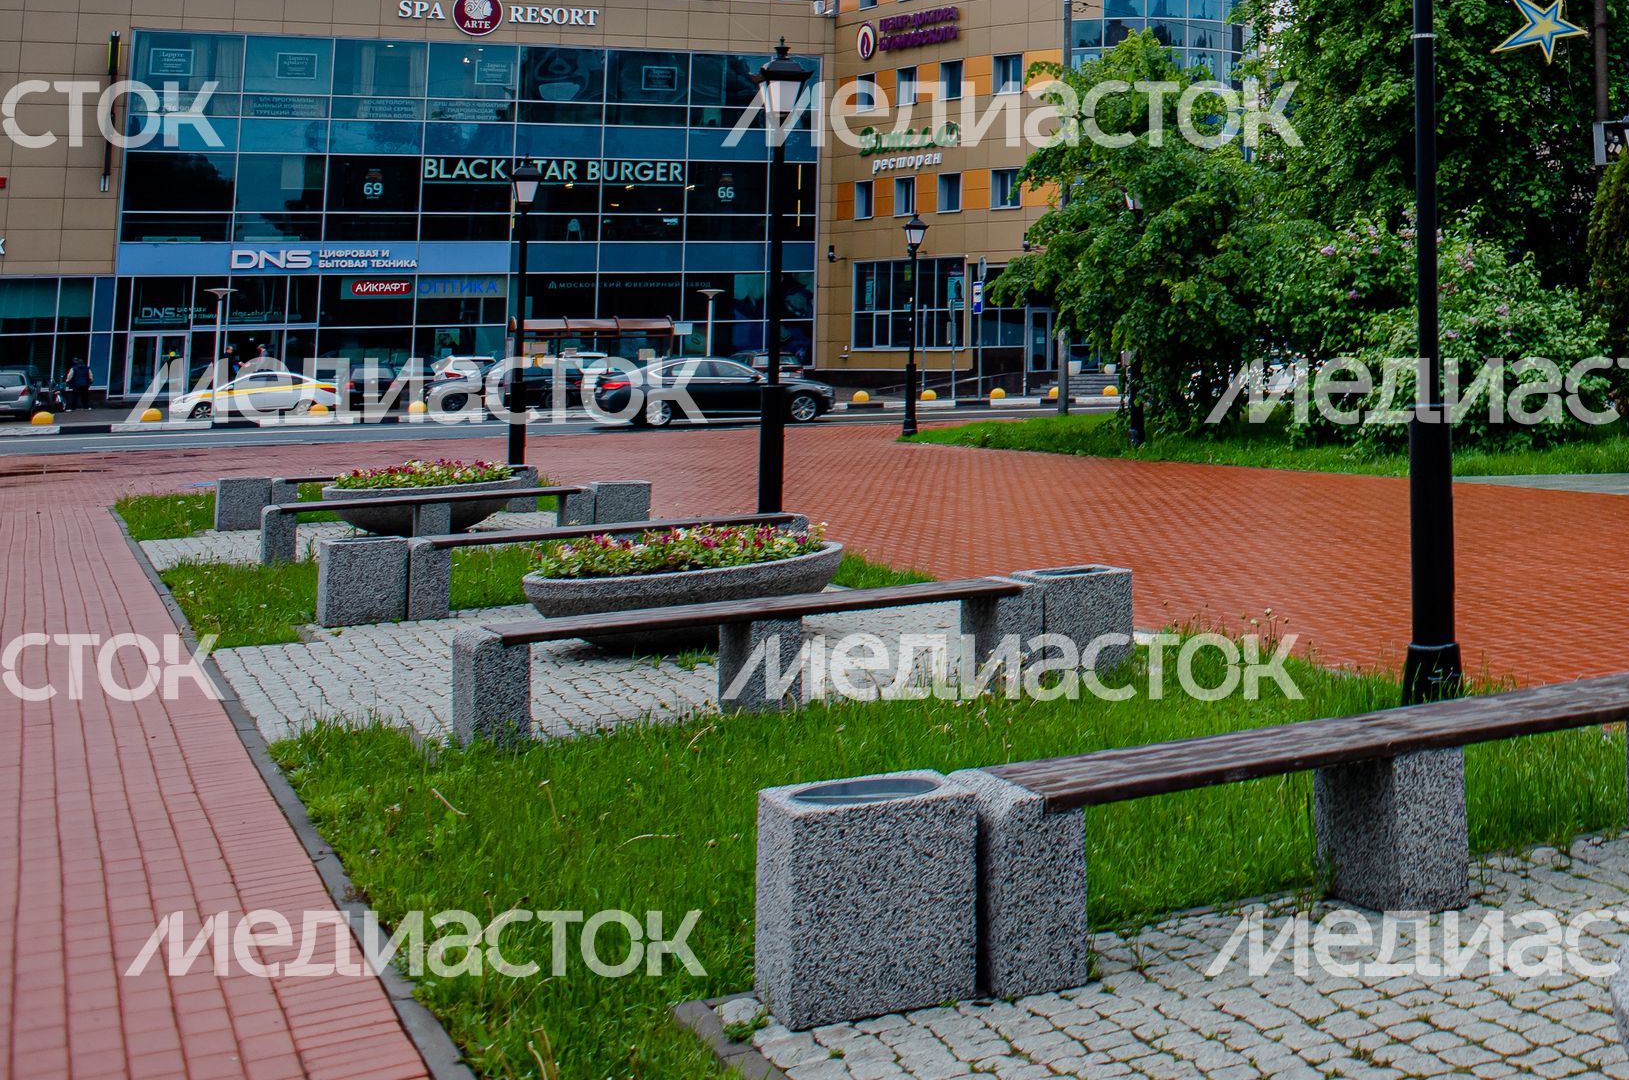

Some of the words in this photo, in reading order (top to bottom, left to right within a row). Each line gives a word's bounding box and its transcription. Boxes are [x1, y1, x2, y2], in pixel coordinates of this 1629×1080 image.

[398, 0, 446, 20] SPA
[509, 5, 600, 26] RESORT
[463, 20, 491, 29] ARTE
[872, 151, 943, 174] ресторан
[424, 158, 507, 180] BLACK
[521, 160, 577, 181] TAR
[586, 161, 684, 183] BURGER
[363, 182, 383, 196] 69
[717, 186, 735, 199] 66
[231, 249, 312, 269] DNS
[319, 249, 380, 259] ЦИФРОВАЯ
[381, 249, 390, 258] И
[318, 259, 369, 269] БЫТОВАЯ
[371, 259, 418, 269] ТЕХНИКА
[355, 281, 409, 293] АЙКРАФТ
[417, 279, 498, 295] ОПТИКА
[141, 307, 175, 318] DNS
